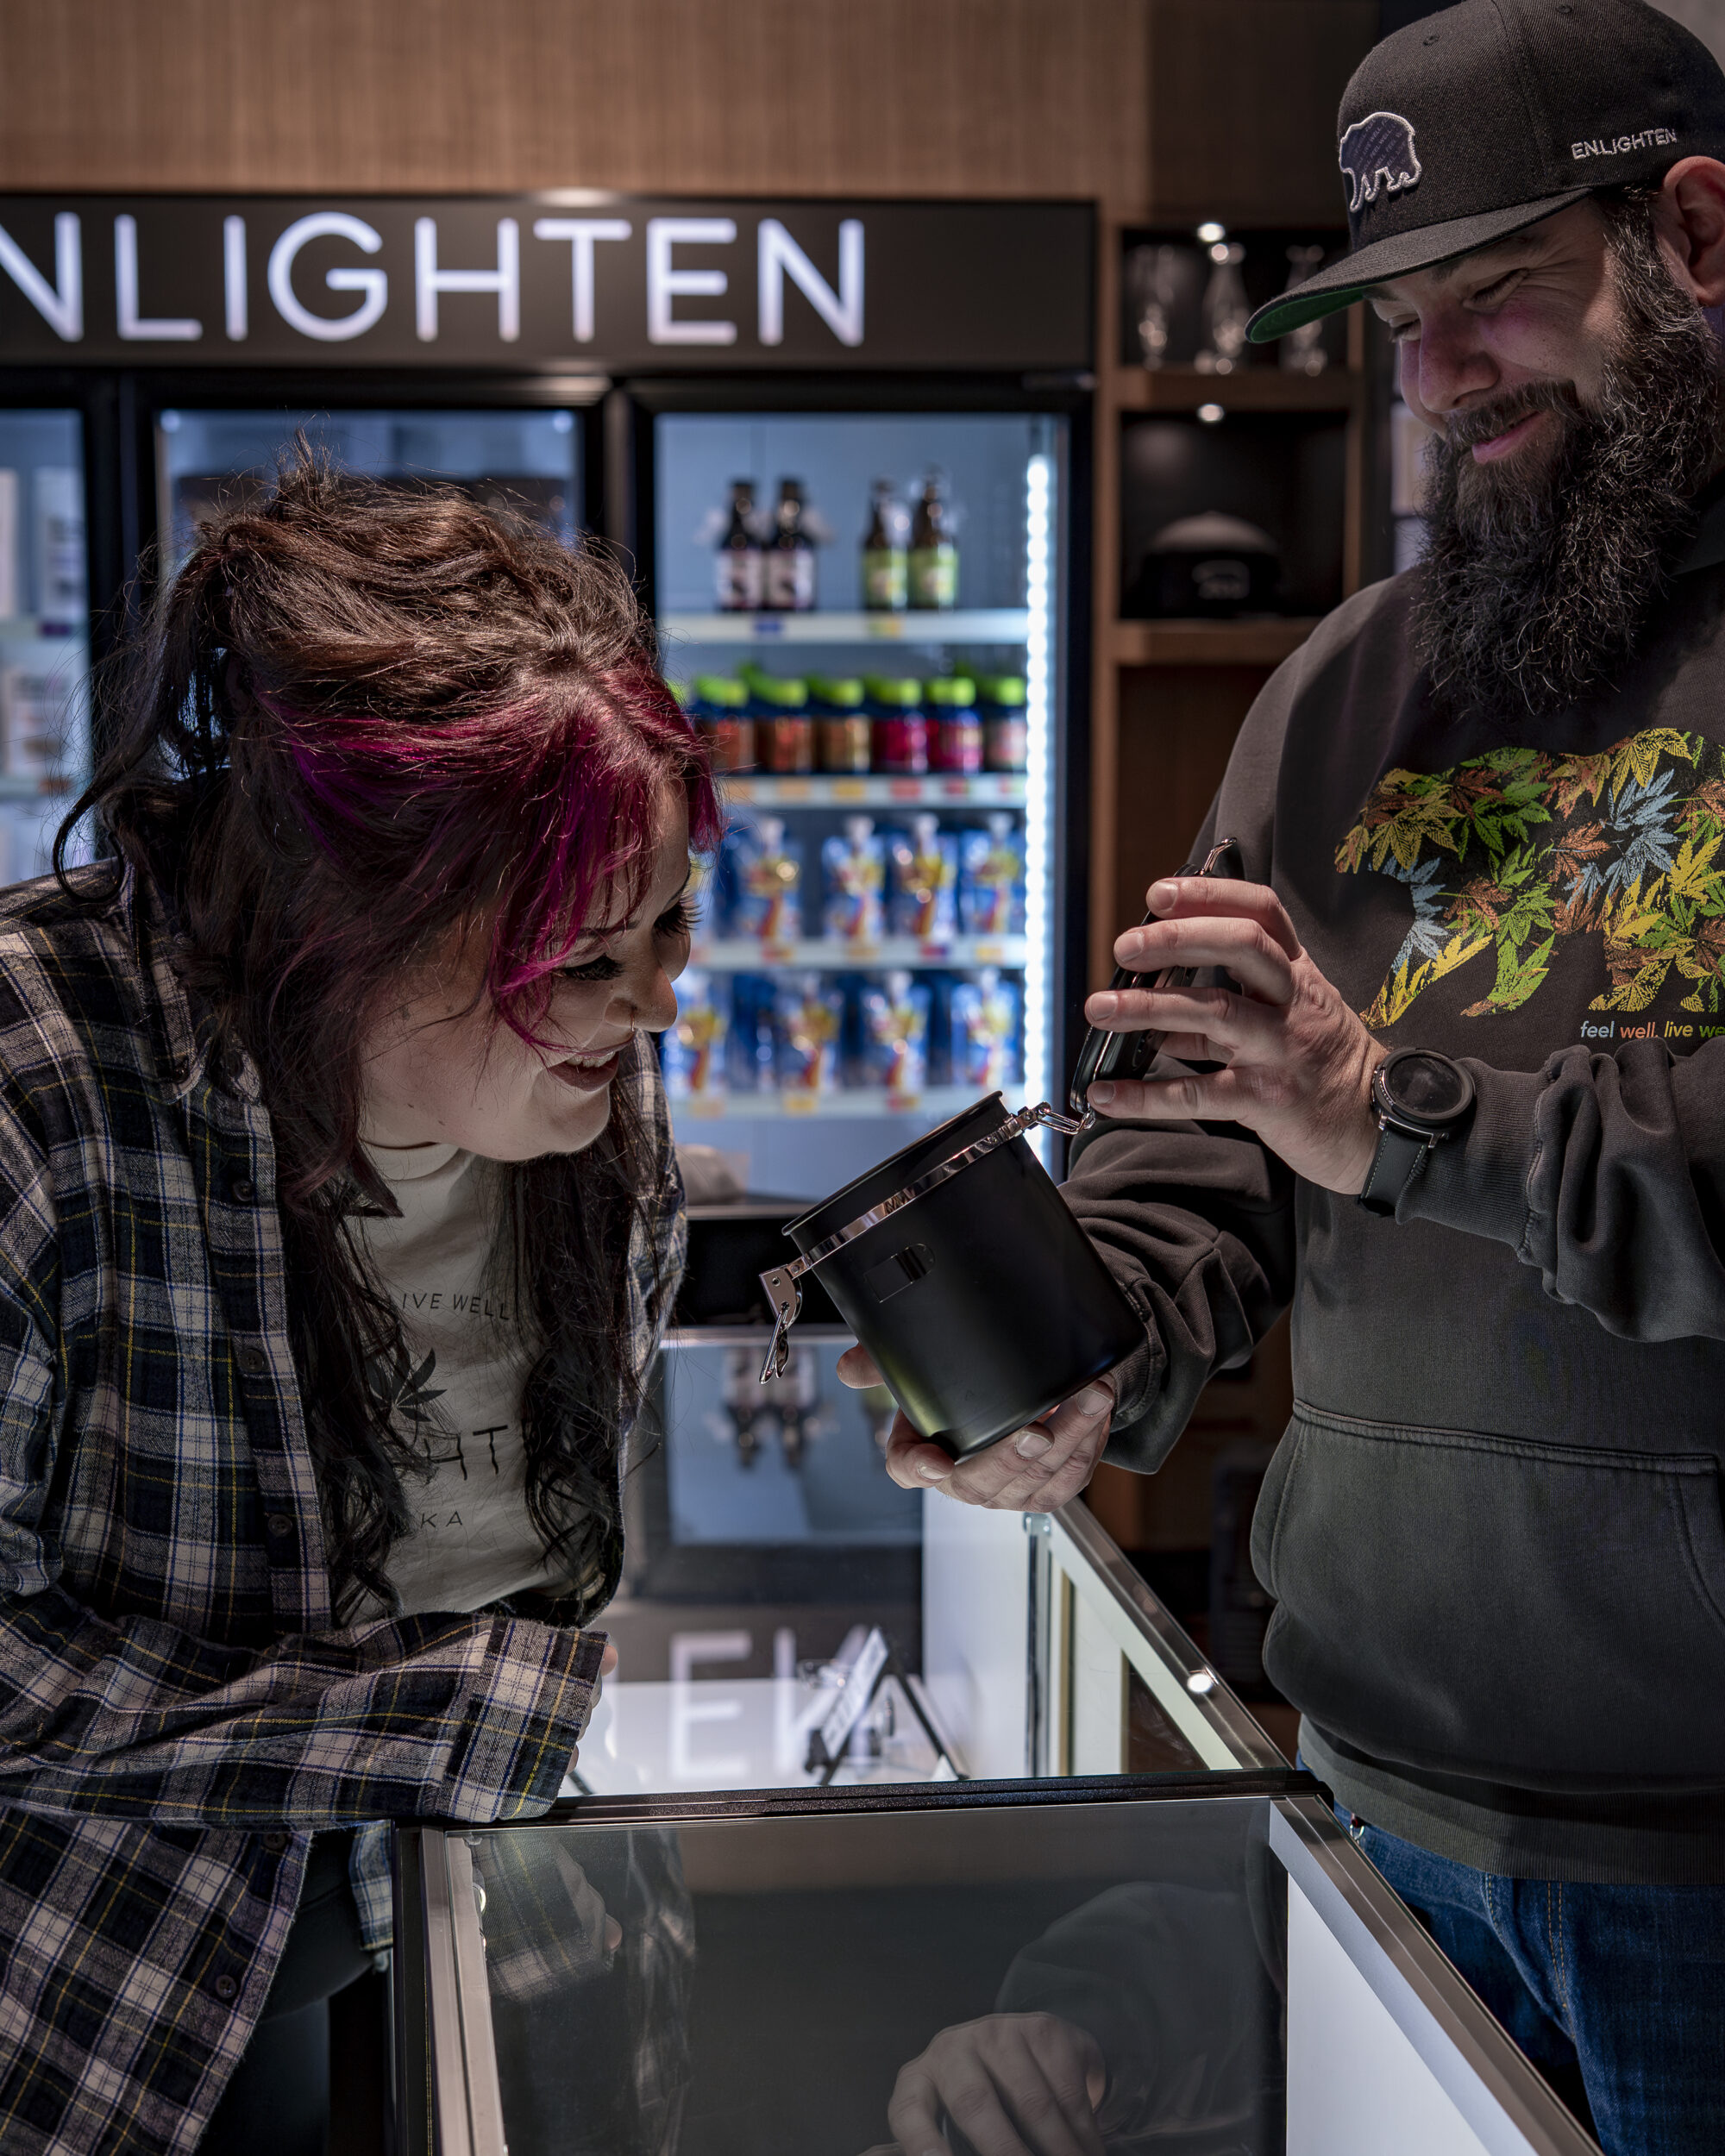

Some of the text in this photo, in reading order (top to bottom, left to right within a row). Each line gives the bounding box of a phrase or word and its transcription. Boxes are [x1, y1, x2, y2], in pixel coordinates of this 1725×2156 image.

[1571, 128, 1677, 160] ENLIGHTEN
[0, 210, 864, 346] NLIGHTEN
[1580, 1020, 1615, 1038] feel
[1664, 1020, 1694, 1037] live
[402, 1293, 511, 1320] IVE WELL
